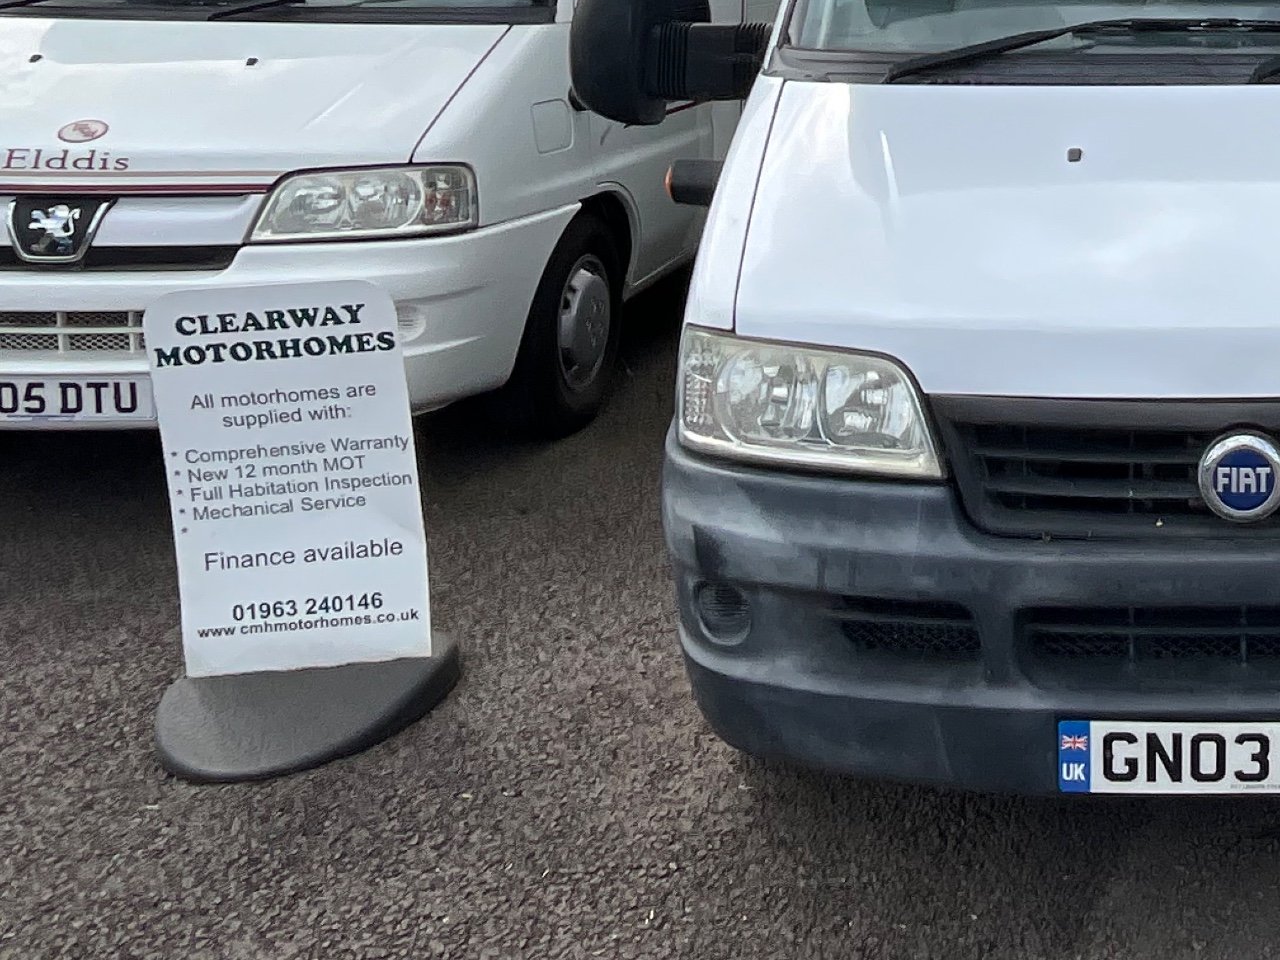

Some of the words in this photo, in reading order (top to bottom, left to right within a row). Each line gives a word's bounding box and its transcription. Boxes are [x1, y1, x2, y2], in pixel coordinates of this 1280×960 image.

[2, 148, 129, 171] Elddis
[175, 304, 365, 336] CLEARWAY
[154, 331, 396, 367] MOTORHOMES
[59, 382, 137, 414] DTU
[190, 394, 214, 410] All
[221, 386, 340, 408] motorhomes
[346, 383, 376, 398] are
[223, 406, 302, 428] supplied
[308, 404, 352, 421] with:
[185, 440, 326, 464] Comprehensive
[331, 435, 409, 453] Warranty
[188, 467, 228, 483] New
[235, 464, 257, 479] 12
[262, 459, 318, 477] month
[323, 455, 366, 472] MOT
[1217, 467, 1270, 493] FIAT
[190, 486, 223, 502] Full
[229, 479, 319, 499] Habitation
[325, 472, 413, 492] Inspection
[193, 499, 294, 520] Mechanical
[301, 494, 367, 512] Service
[205, 550, 296, 571] Finance
[303, 538, 404, 563] available
[232, 600, 298, 621] 01963
[305, 592, 384, 615] 240146
[197, 608, 420, 638] wwwcmhmotorhomes.co.uk
[1103, 732, 1270, 782] GN03
[1062, 763, 1086, 782] UK
